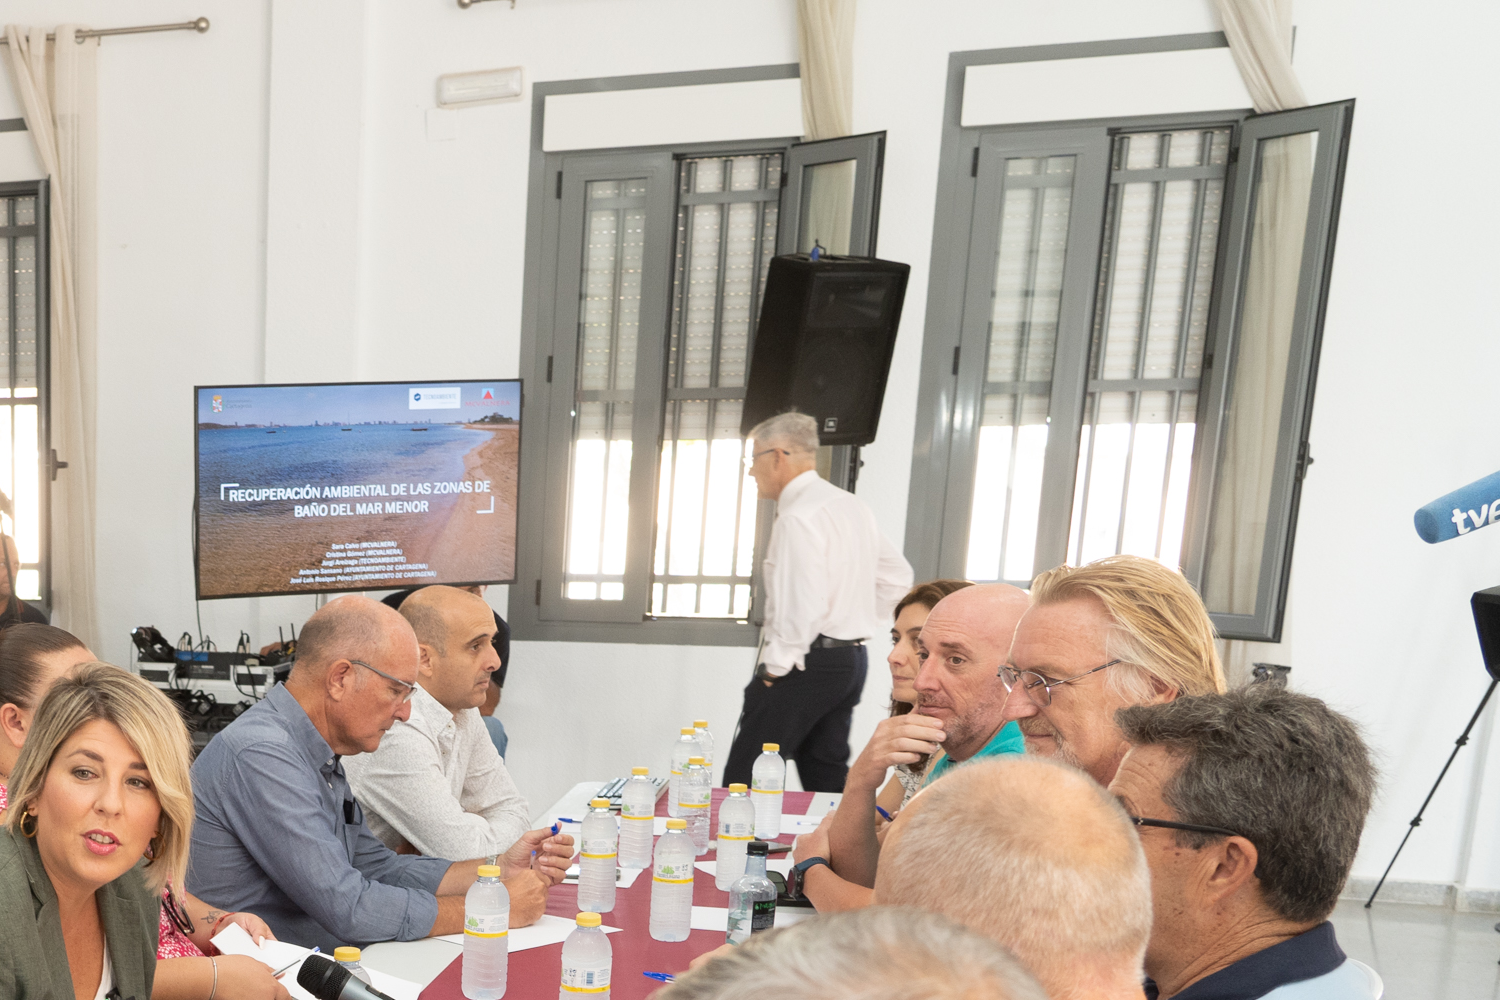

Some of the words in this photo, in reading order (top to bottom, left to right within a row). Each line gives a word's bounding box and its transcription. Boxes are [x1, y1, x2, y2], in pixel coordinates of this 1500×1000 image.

[229, 484, 321, 502] RECUPERACIÓN
[322, 484, 390, 498] AMBIENTAL
[391, 483, 408, 496] DE
[409, 482, 432, 495] LAS
[433, 481, 473, 495] ZONAS
[474, 480, 492, 493] DE
[294, 502, 329, 517] BAÑO
[330, 504, 354, 516] DEL
[355, 502, 383, 515] MAR
[384, 500, 430, 514] MENOR
